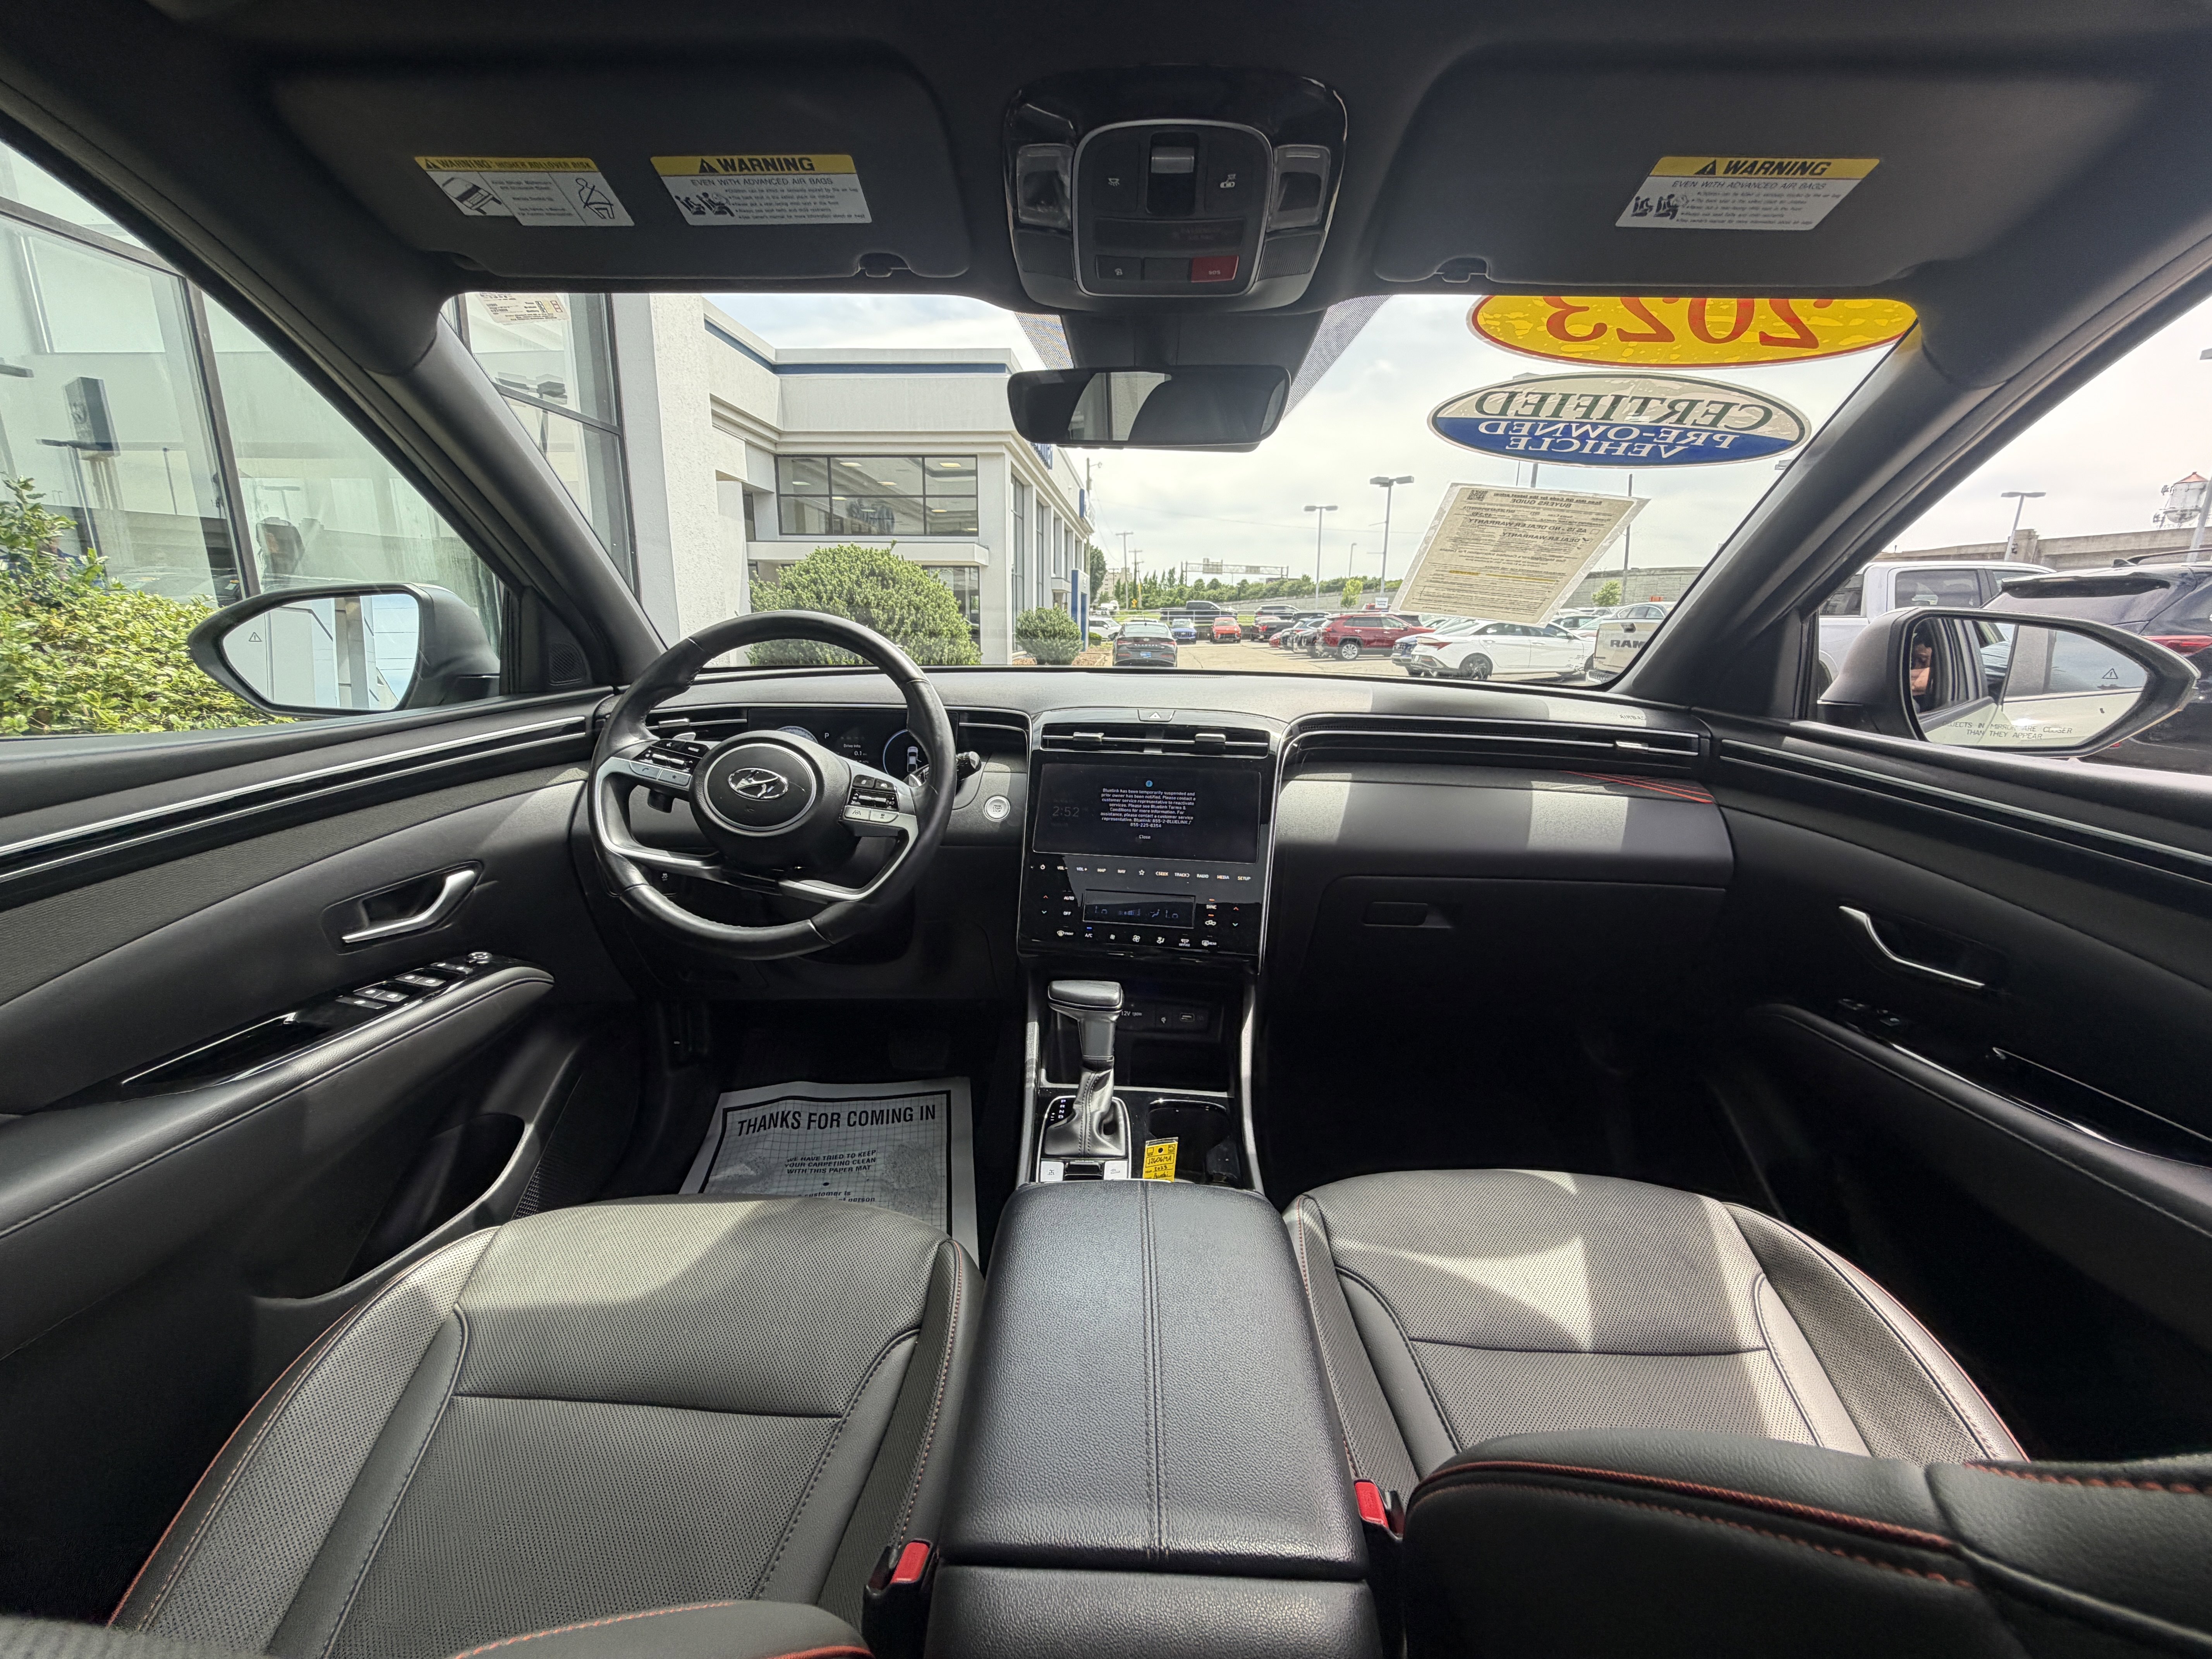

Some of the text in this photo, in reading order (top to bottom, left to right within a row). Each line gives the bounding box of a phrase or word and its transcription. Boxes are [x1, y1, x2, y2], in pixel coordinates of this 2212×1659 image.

[529, 161, 570, 169] ROLLOVER
[571, 161, 592, 169] RISK
[716, 158, 815, 172] WARNING
[1722, 161, 1831, 175] WARNING
[1610, 640, 1646, 648] RAM
[1052, 806, 1080, 817] 2:52
[738, 1104, 936, 1136] THANKS FOR COMING IN
